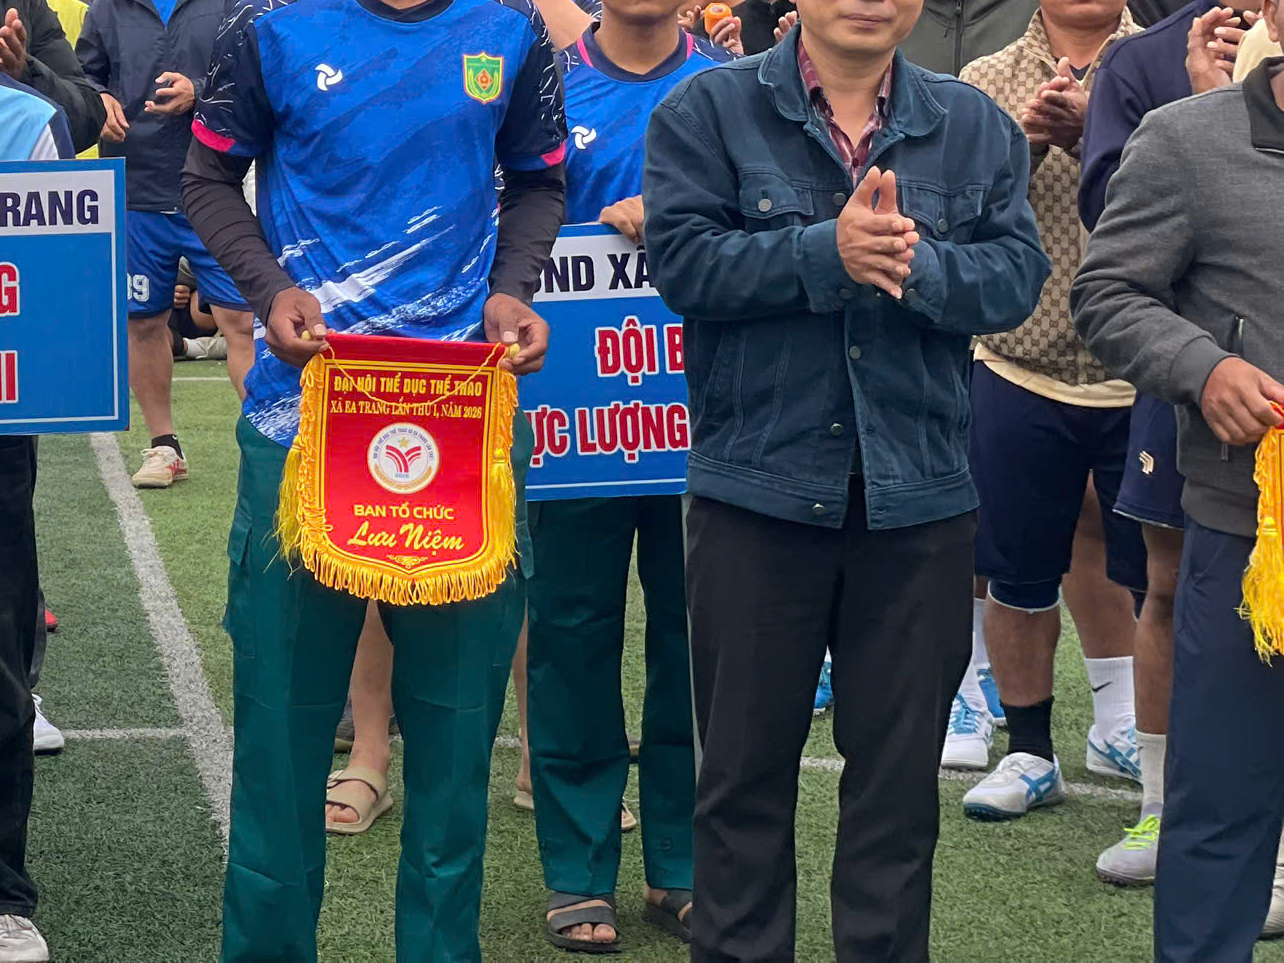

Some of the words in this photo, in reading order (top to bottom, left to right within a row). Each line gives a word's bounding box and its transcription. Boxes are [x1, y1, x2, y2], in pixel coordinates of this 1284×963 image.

[127, 273, 149, 302] 9
[534, 255, 595, 293] ND
[596, 317, 656, 385] ĐỘI
[334, 375, 354, 394] ĐẠI
[380, 373, 402, 393] THỂ
[403, 378, 427, 396] DỤC
[430, 375, 452, 395] THỂ
[454, 380, 483, 397] THAO
[345, 400, 357, 414] EA
[358, 400, 390, 415] TRANG
[463, 405, 483, 419] 2026
[524, 404, 570, 468] ỰC
[575, 400, 691, 463] LƯỢNG
[353, 504, 387, 517] BAN
[389, 501, 410, 518] TỔ
[413, 504, 455, 519] CHỨC
[399, 523, 464, 556] Niệm
